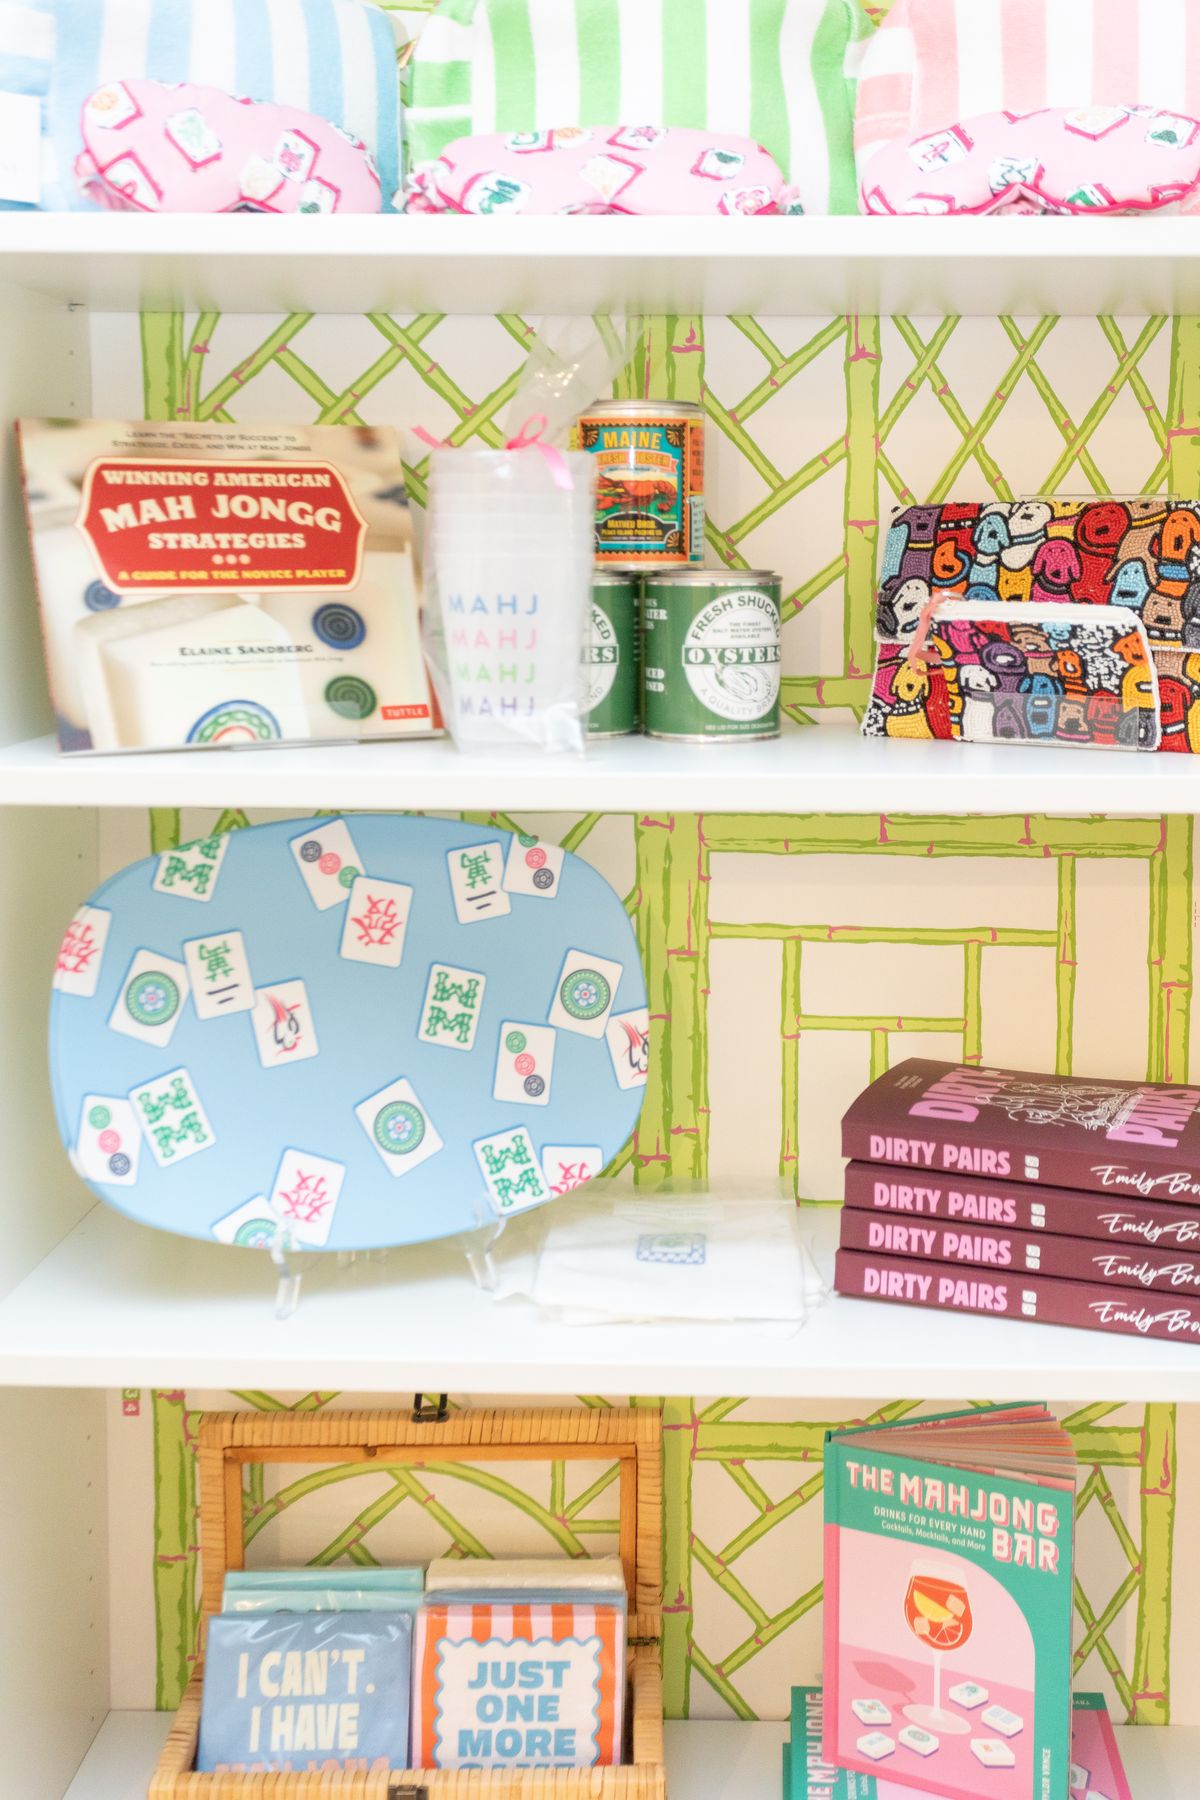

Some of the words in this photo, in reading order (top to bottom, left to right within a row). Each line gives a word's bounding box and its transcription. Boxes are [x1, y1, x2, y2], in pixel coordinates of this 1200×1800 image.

[603, 431, 663, 449] MAINE
[101, 470, 210, 487] WINNING
[213, 472, 331, 488] AMERICAN
[98, 494, 197, 533] MAH
[210, 494, 343, 533] JONGG
[147, 532, 307, 550] STRATEGIES
[118, 570, 130, 580] A
[131, 570, 179, 580] GUIDE
[180, 570, 209, 580] FOR
[211, 570, 241, 580] THE
[242, 569, 294, 580] NOVICE
[295, 568, 347, 579] PLAYER
[448, 593, 538, 616] MAHJ
[692, 598, 734, 640] FRESH
[179, 647, 232, 657] ELAINE
[237, 645, 313, 655] SANDBERG
[452, 628, 537, 651] MAHJ
[688, 648, 781, 664] OYSTERS
[457, 662, 537, 684] MAHJ
[386, 707, 424, 718] TUTTLE
[460, 695, 535, 718] MAHJ
[908, 1067, 1016, 1123] DIRTY
[1105, 1086, 1200, 1148] PAIRS
[870, 1135, 936, 1166] DIRTY
[943, 1144, 1010, 1176] PAIRS
[1090, 1165, 1157, 1195] Emily
[1157, 1172, 1200, 1195] Bro
[874, 1182, 941, 1215] DIRTY
[948, 1192, 1017, 1223] PAIRS
[1097, 1213, 1163, 1243] Emily
[1163, 1221, 1200, 1243] Br
[869, 1222, 936, 1255] DIRTY
[943, 1232, 1011, 1266] PAIRS
[1092, 1255, 1158, 1287] Emily
[864, 1268, 932, 1301] DIRTY
[938, 1277, 1008, 1312] PAIRS
[1088, 1301, 1155, 1333] Emily
[1155, 1309, 1200, 1334] Bro
[846, 1460, 895, 1496] THE
[900, 1472, 1060, 1537] MAHJONG
[873, 1506, 906, 1521] DRINKS
[909, 1513, 927, 1527] FOR
[929, 1518, 958, 1533] EVERY
[960, 1525, 986, 1540] HAND
[881, 1520, 914, 1537] Cocktails,
[916, 1528, 951, 1545] Mocktails,
[952, 1537, 966, 1546] and
[967, 1540, 986, 1552] More
[992, 1527, 1060, 1575] BAR
[237, 1652, 249, 1699] I
[259, 1647, 376, 1697] CAN'T.
[467, 1660, 572, 1690] JUST
[475, 1694, 561, 1724] ONE
[249, 1706, 262, 1753] I
[270, 1703, 360, 1753] HAVE
[457, 1728, 577, 1758] MORE
